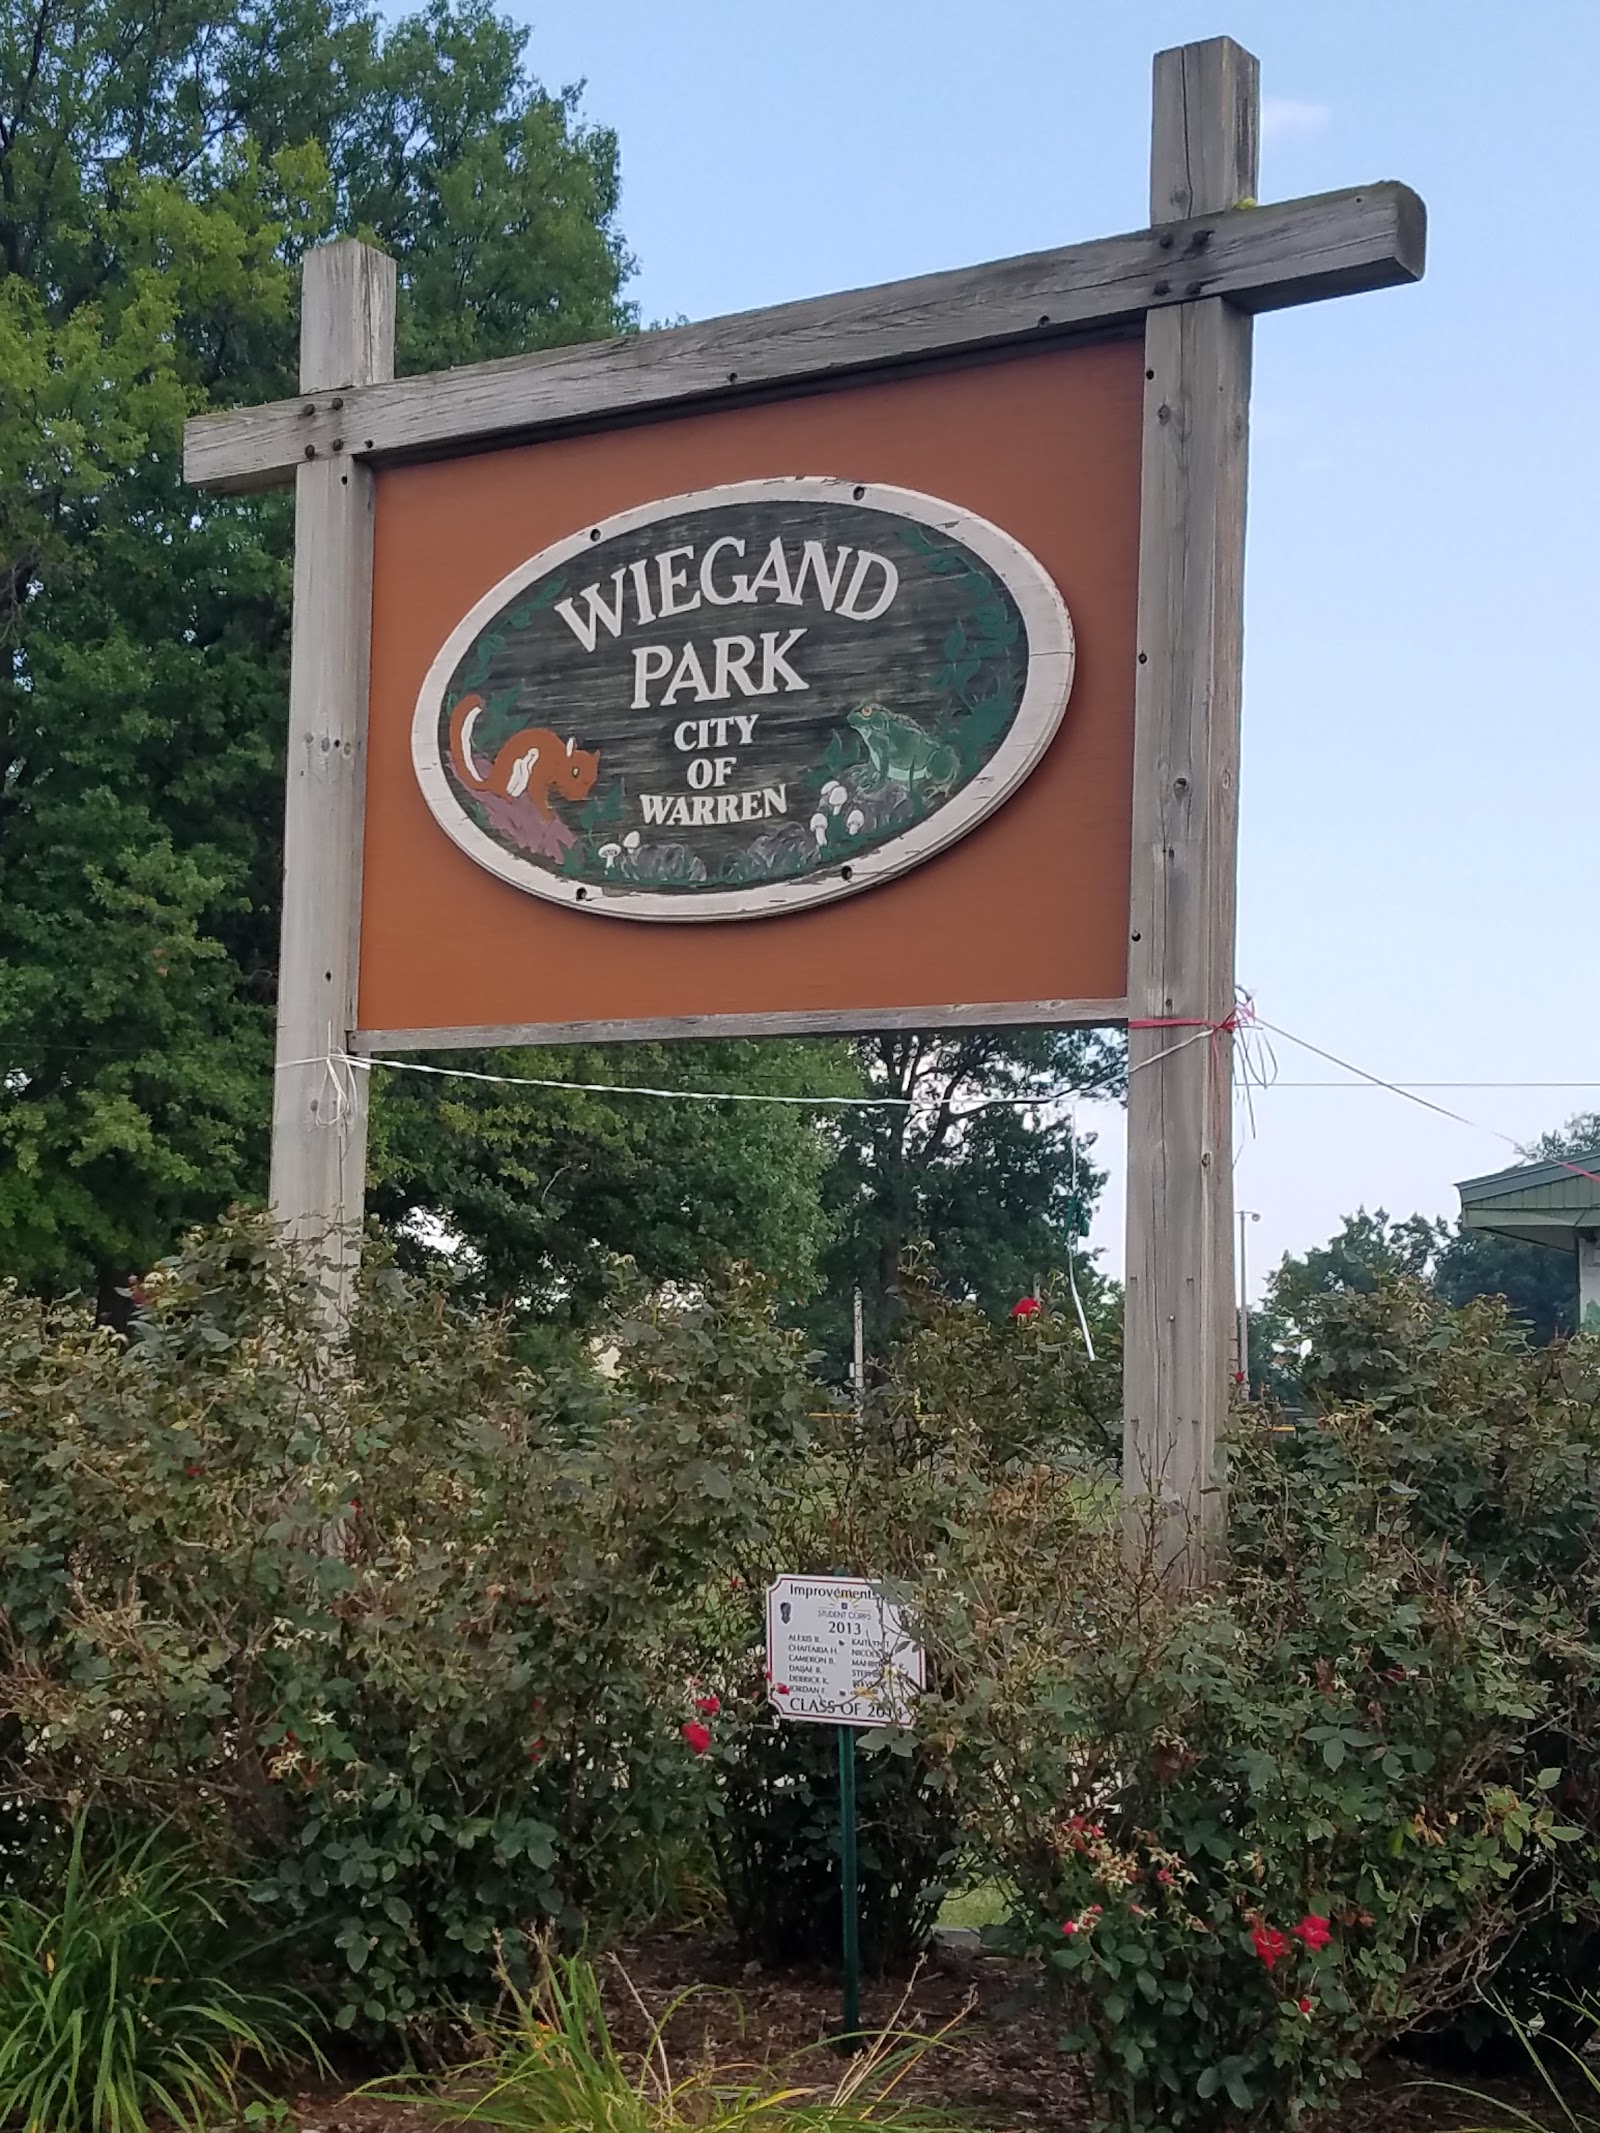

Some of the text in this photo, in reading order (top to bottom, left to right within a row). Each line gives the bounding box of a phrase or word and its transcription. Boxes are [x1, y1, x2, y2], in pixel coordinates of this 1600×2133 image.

[554, 536, 898, 652] WIEGAND
[630, 628, 809, 709] PARK
[674, 714, 760, 752] CITY
[687, 757, 737, 789] OF
[639, 784, 788, 826] WARREN
[818, 1610, 871, 1620] STUDENT CORPS
[828, 1621, 861, 1635] 2013
[790, 1697, 835, 1714] CLASS
[841, 1702, 861, 1715] OF
